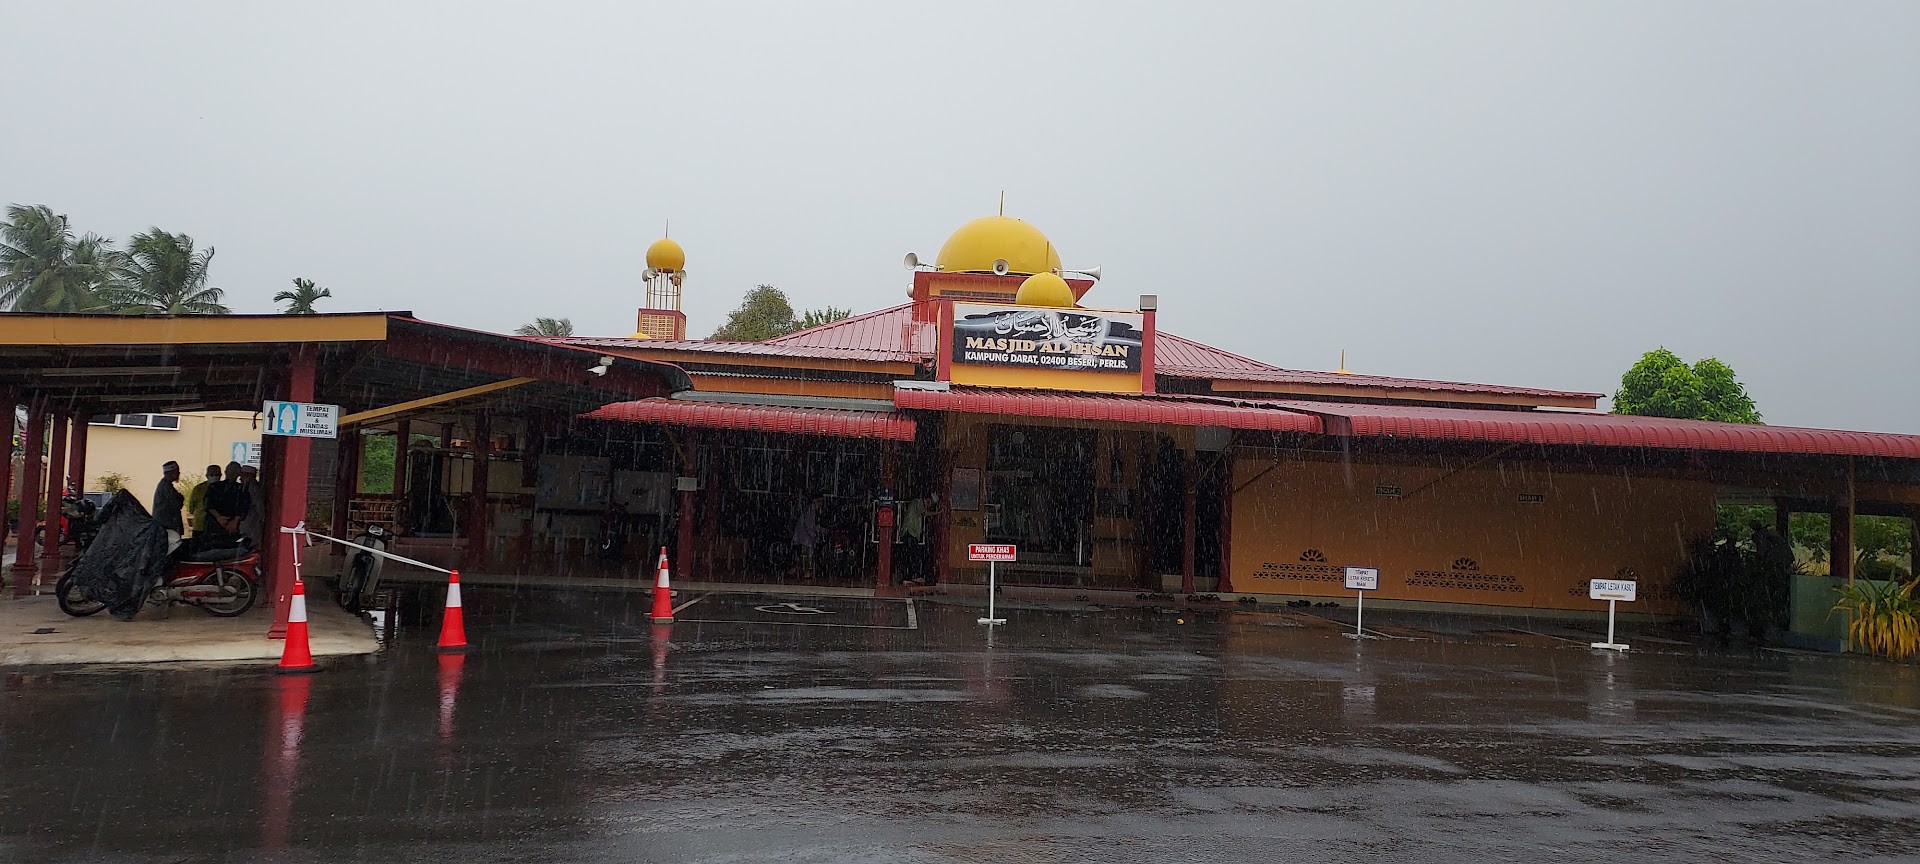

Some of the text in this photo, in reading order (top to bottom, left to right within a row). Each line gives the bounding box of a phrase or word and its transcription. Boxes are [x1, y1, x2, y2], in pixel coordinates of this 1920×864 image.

[965, 336, 1036, 354] MASJID
[964, 351, 1128, 369] KAMPUNG DARAT, 02400 BESERI, PERLIS.
[306, 405, 330, 413] TEMPAT
[306, 411, 329, 419] WUDUK
[304, 422, 329, 430] TANDAS
[299, 428, 333, 436] MUSLIMAH
[975, 546, 1010, 554] PARKING KHAS
[1592, 581, 1635, 592] TEMPAT LETAK KASUT
